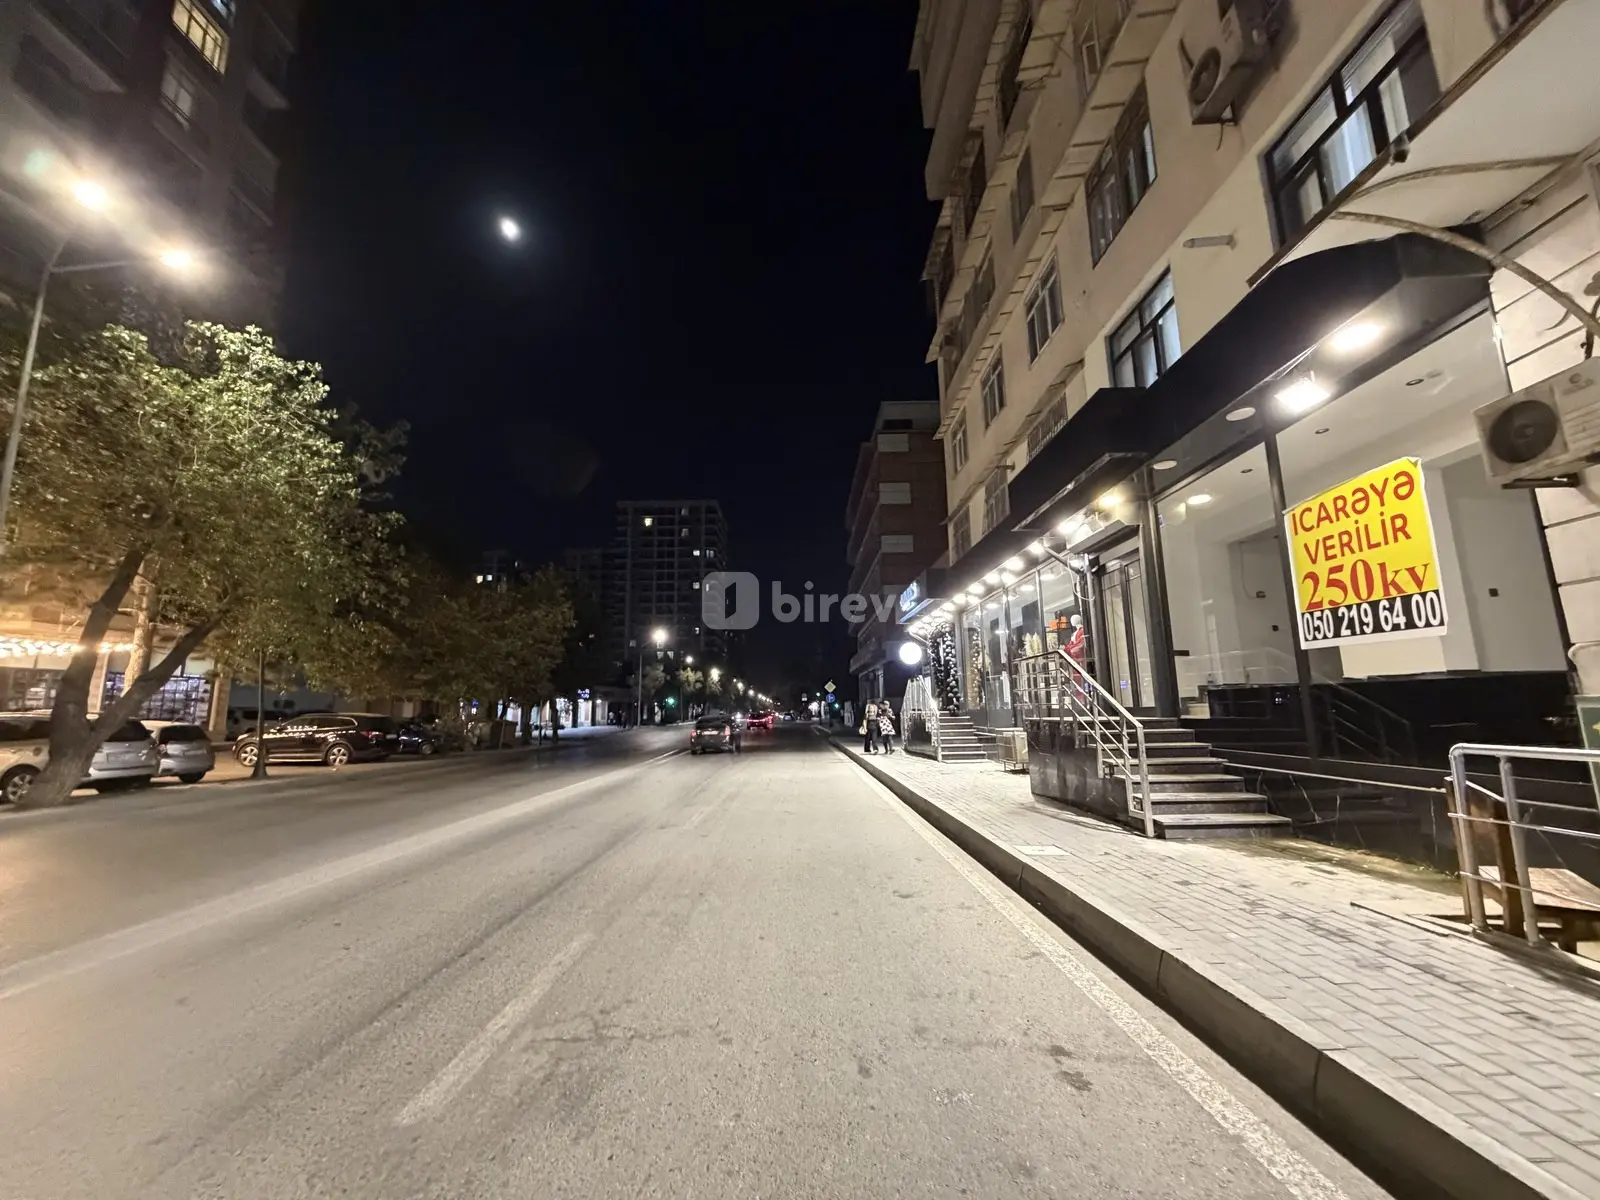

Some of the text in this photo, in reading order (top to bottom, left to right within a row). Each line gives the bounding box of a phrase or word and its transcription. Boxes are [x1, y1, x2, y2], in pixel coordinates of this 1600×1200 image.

[1303, 511, 1412, 565] VERİLİR
[1303, 591, 1441, 641] 050 219 64 00
